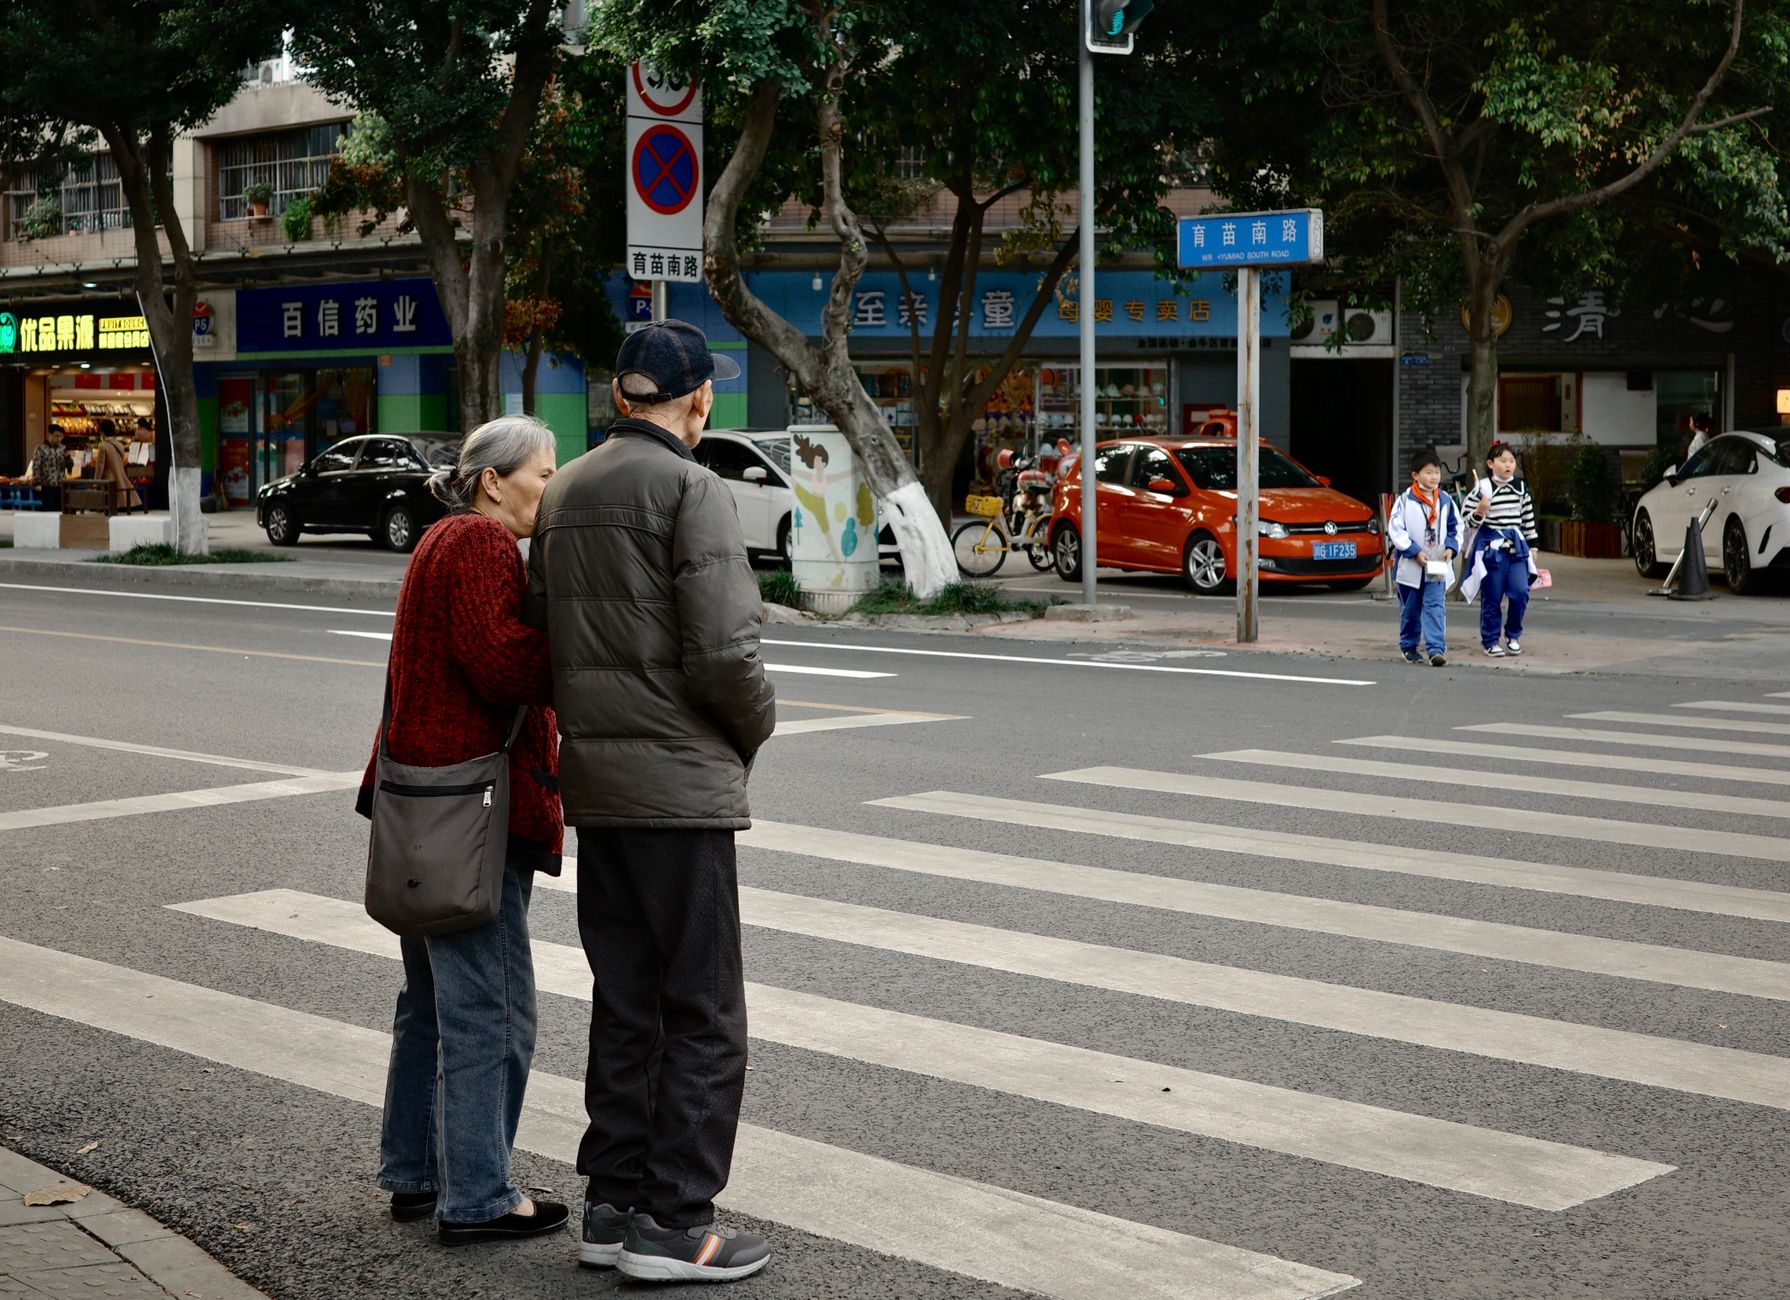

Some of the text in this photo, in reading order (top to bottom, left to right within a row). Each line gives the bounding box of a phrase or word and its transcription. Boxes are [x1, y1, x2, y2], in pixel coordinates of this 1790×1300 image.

[1192, 218, 1297, 248] 育苗南路
[632, 251, 698, 278] 育苗南路
[1247, 251, 1269, 260] SOUTH
[1271, 249, 1289, 258] ROAD
[282, 295, 418, 338] 百信药业
[1058, 299, 1210, 323] 母婴专卖店
[20, 314, 94, 352] 优品果源
